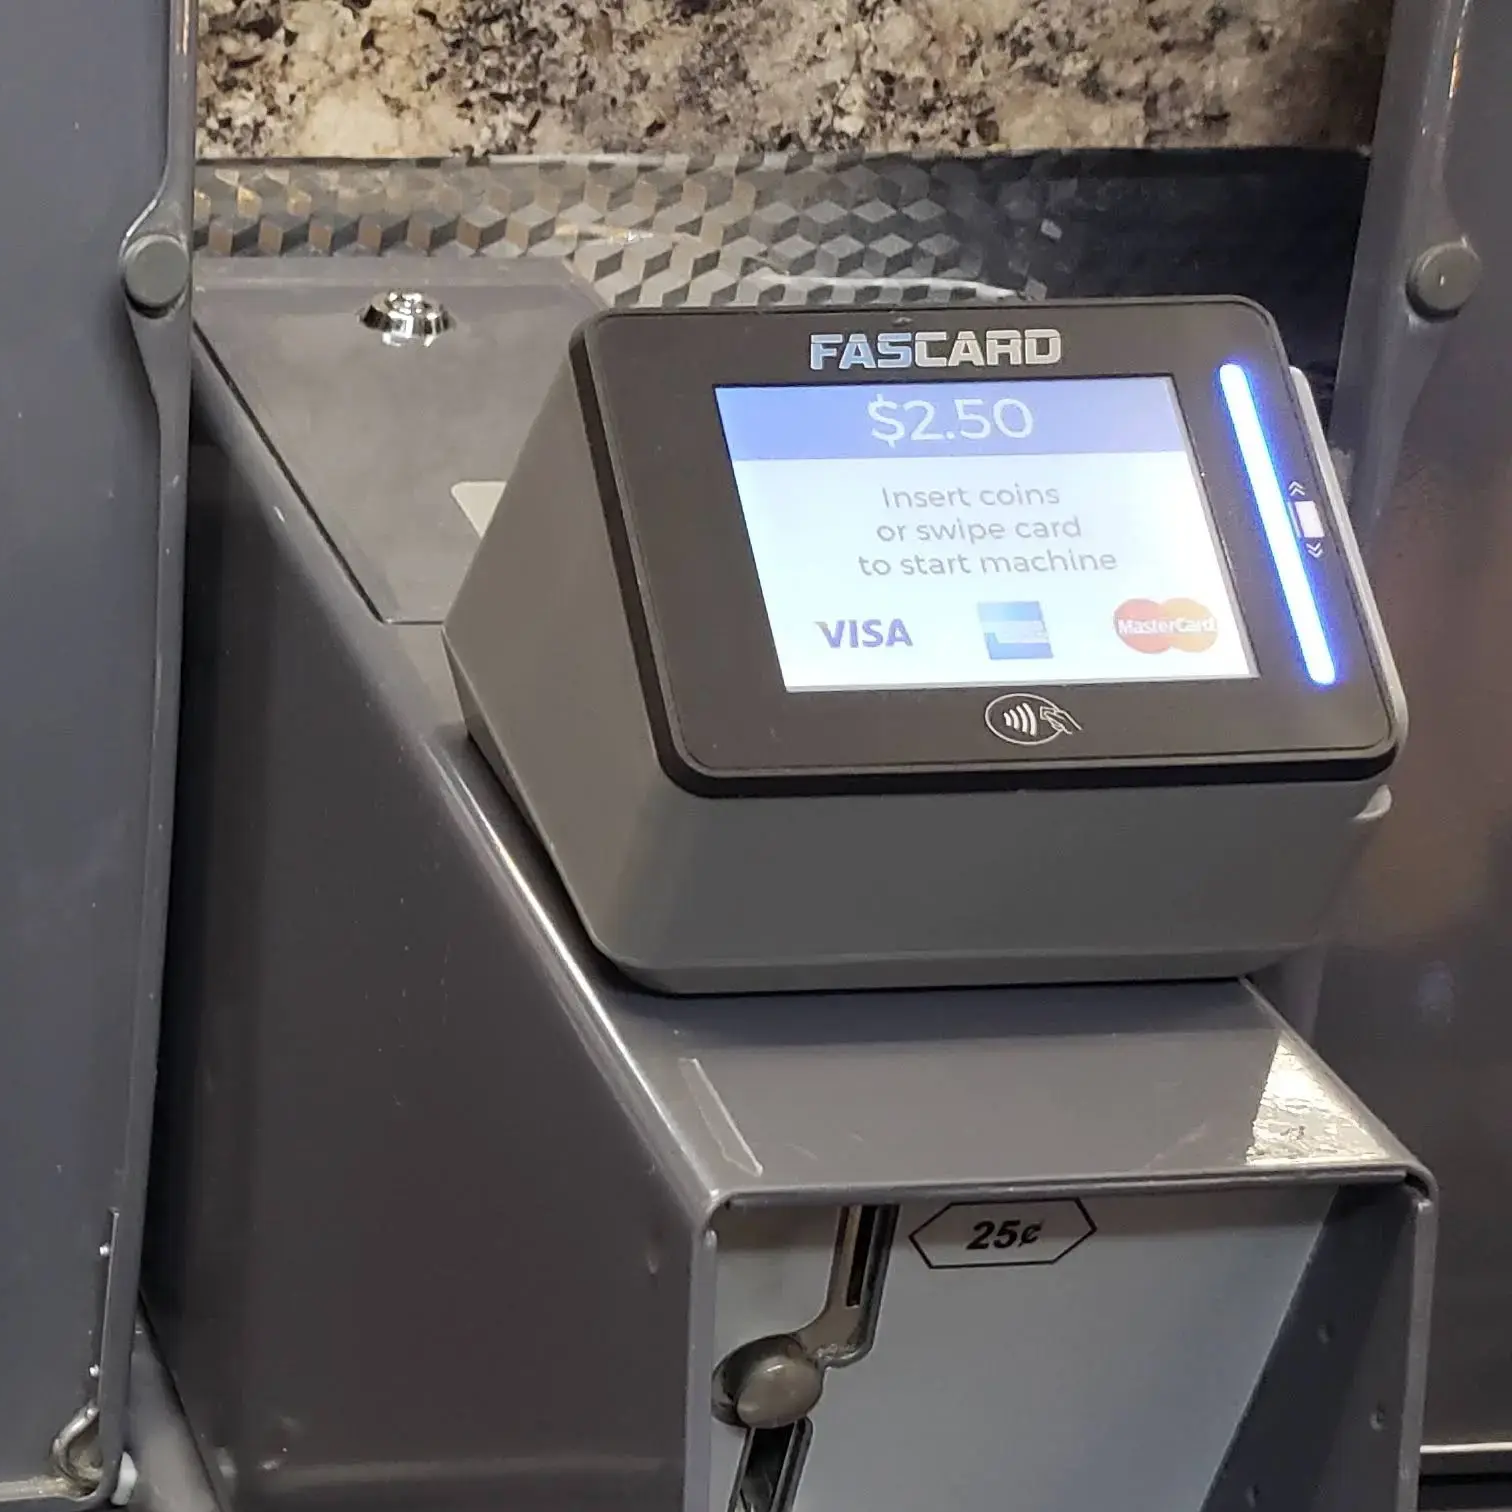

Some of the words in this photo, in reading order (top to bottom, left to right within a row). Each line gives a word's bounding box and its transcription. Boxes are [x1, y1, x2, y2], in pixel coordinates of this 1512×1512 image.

[810, 329, 1063, 370] FASCARD
[868, 394, 1035, 449] $2.50
[882, 485, 971, 508] Insert
[979, 484, 1060, 507] coins
[876, 523, 906, 543] or
[913, 519, 1009, 548] swipe
[1017, 516, 1082, 540] card
[859, 555, 894, 576] to
[901, 551, 971, 575] start
[980, 549, 1118, 573] machine
[815, 618, 913, 648] VISA
[1117, 616, 1217, 636] MasterCard
[965, 1219, 1045, 1250] 25¢
